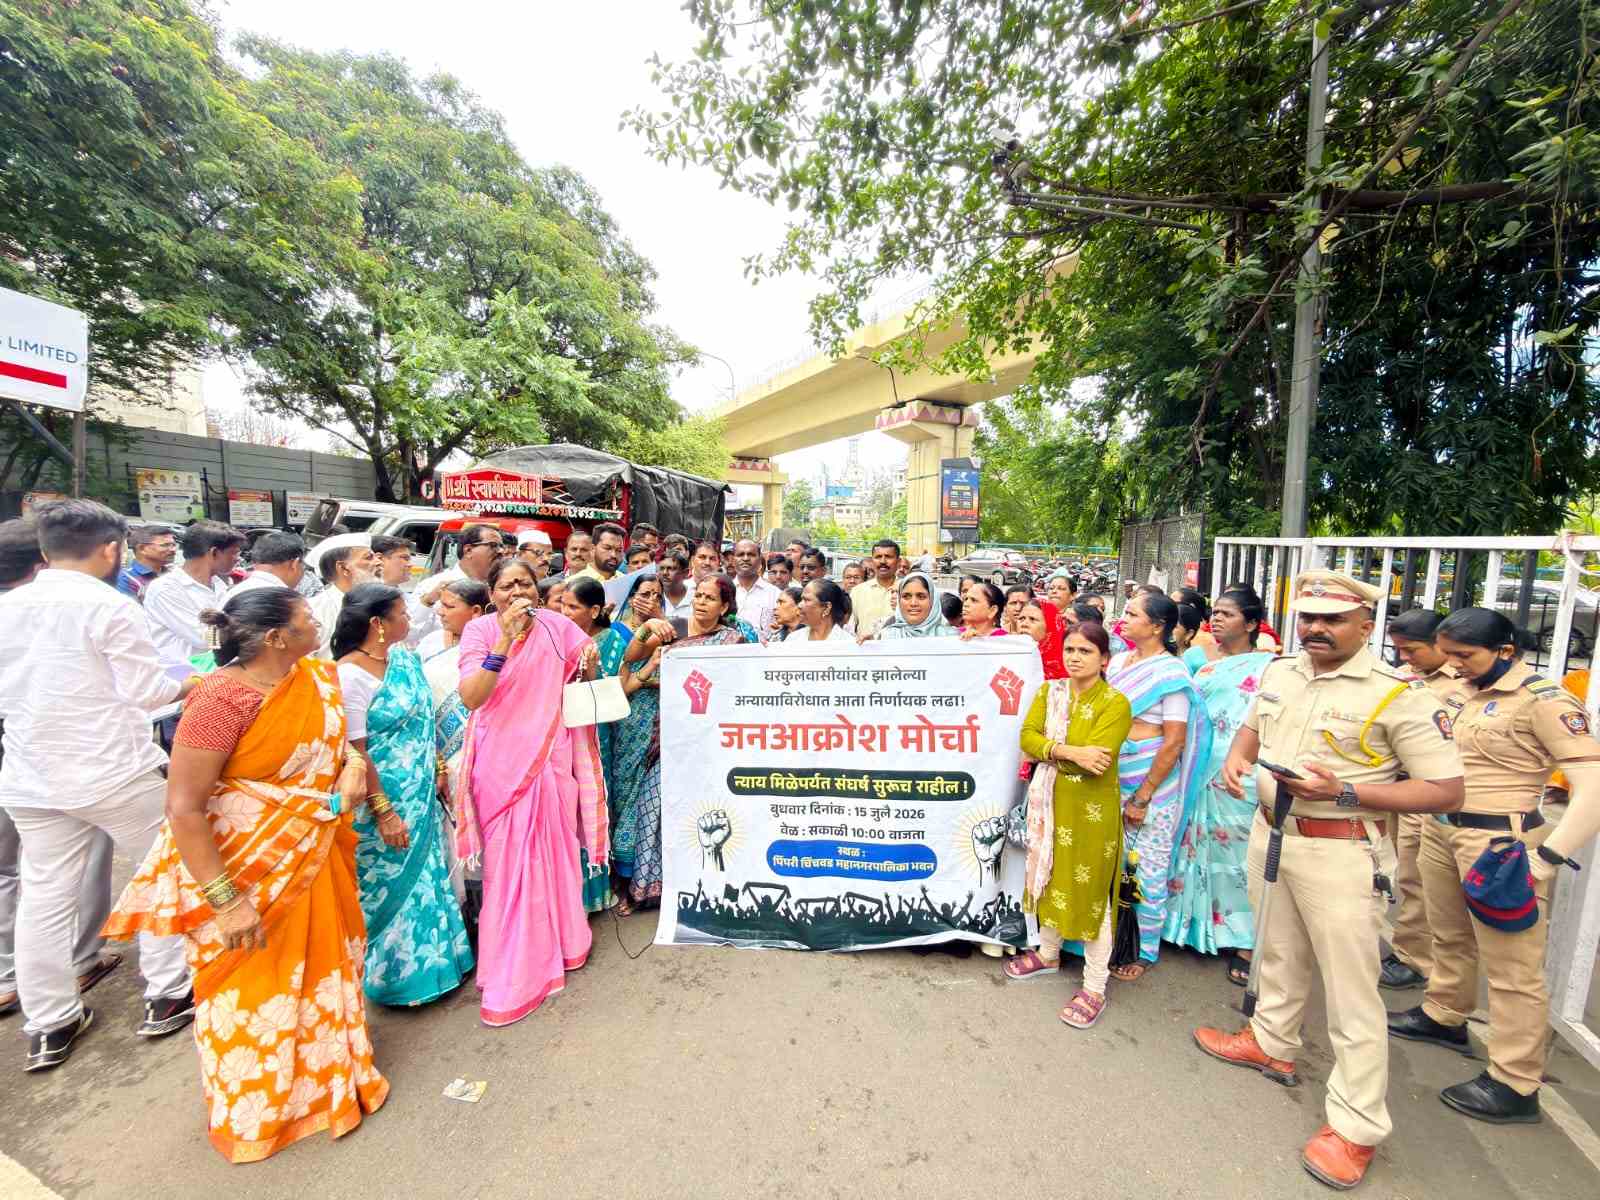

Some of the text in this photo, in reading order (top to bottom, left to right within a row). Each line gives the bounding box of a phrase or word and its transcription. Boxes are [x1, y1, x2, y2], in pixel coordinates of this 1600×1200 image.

[8, 336, 78, 363] LIMITED
[764, 666, 927, 686] घरकुलवासीयांवर झालेल्या
[735, 691, 830, 707] अन्यायाविरोधात
[834, 695, 866, 707] आता
[868, 691, 928, 707] निर्णायक
[719, 714, 981, 753] जनआक्रोश मोर्चा
[733, 775, 768, 789] न्याय
[833, 774, 870, 792] संघर्ष
[915, 775, 960, 796] राहील
[770, 803, 807, 818] बुधवार
[809, 801, 845, 815] दिनांक
[854, 806, 867, 817] 15
[869, 804, 891, 822] जुलै
[894, 808, 925, 820] 2026
[779, 821, 800, 836] वेळ
[807, 823, 848, 837] सकाळी
[851, 827, 886, 840] 10:00
[888, 829, 926, 841] वाजता
